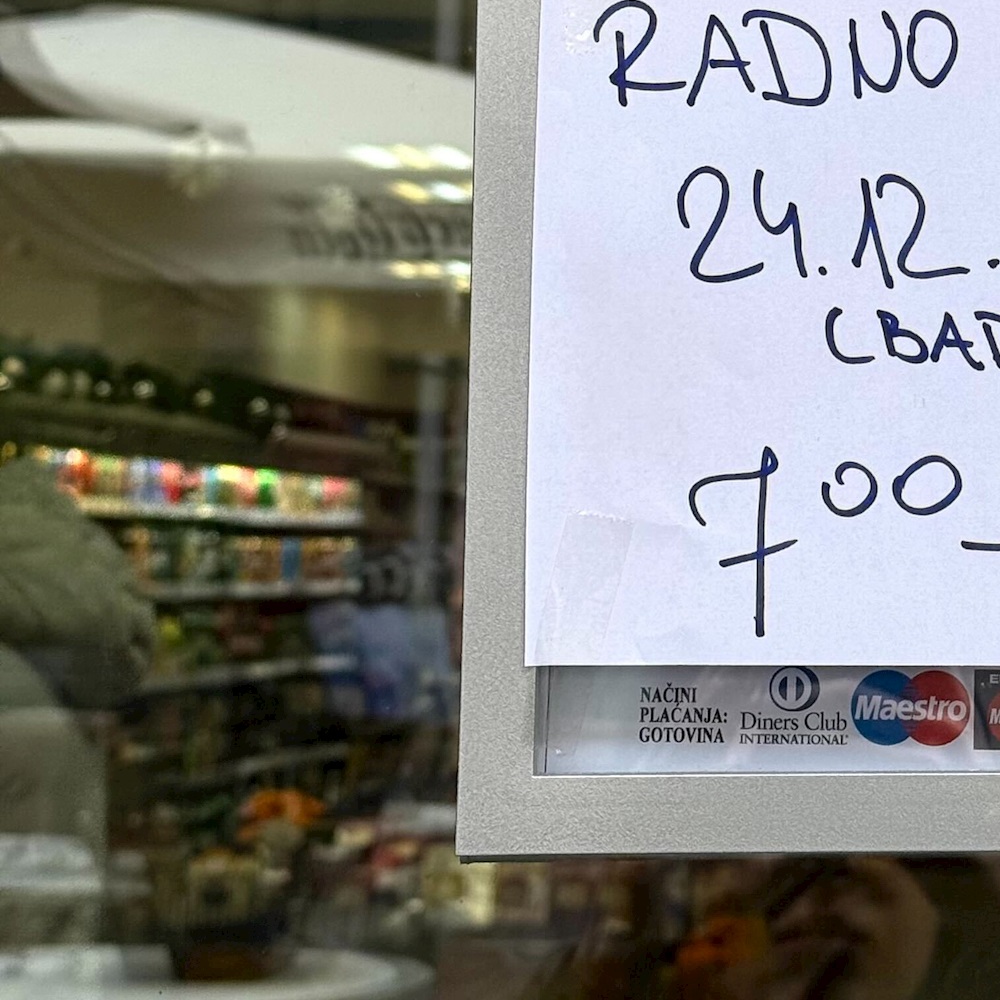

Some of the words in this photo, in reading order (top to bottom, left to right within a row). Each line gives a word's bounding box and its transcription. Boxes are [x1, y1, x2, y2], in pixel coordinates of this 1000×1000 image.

[594, 0, 958, 107] RADNO
[639, 683, 697, 703] NAČINI
[639, 704, 728, 723] PLAĆANJA:
[854, 696, 967, 721] Maestro
[740, 711, 799, 731] Diners
[804, 712, 847, 731] Club
[639, 727, 725, 743] GOTOVINA
